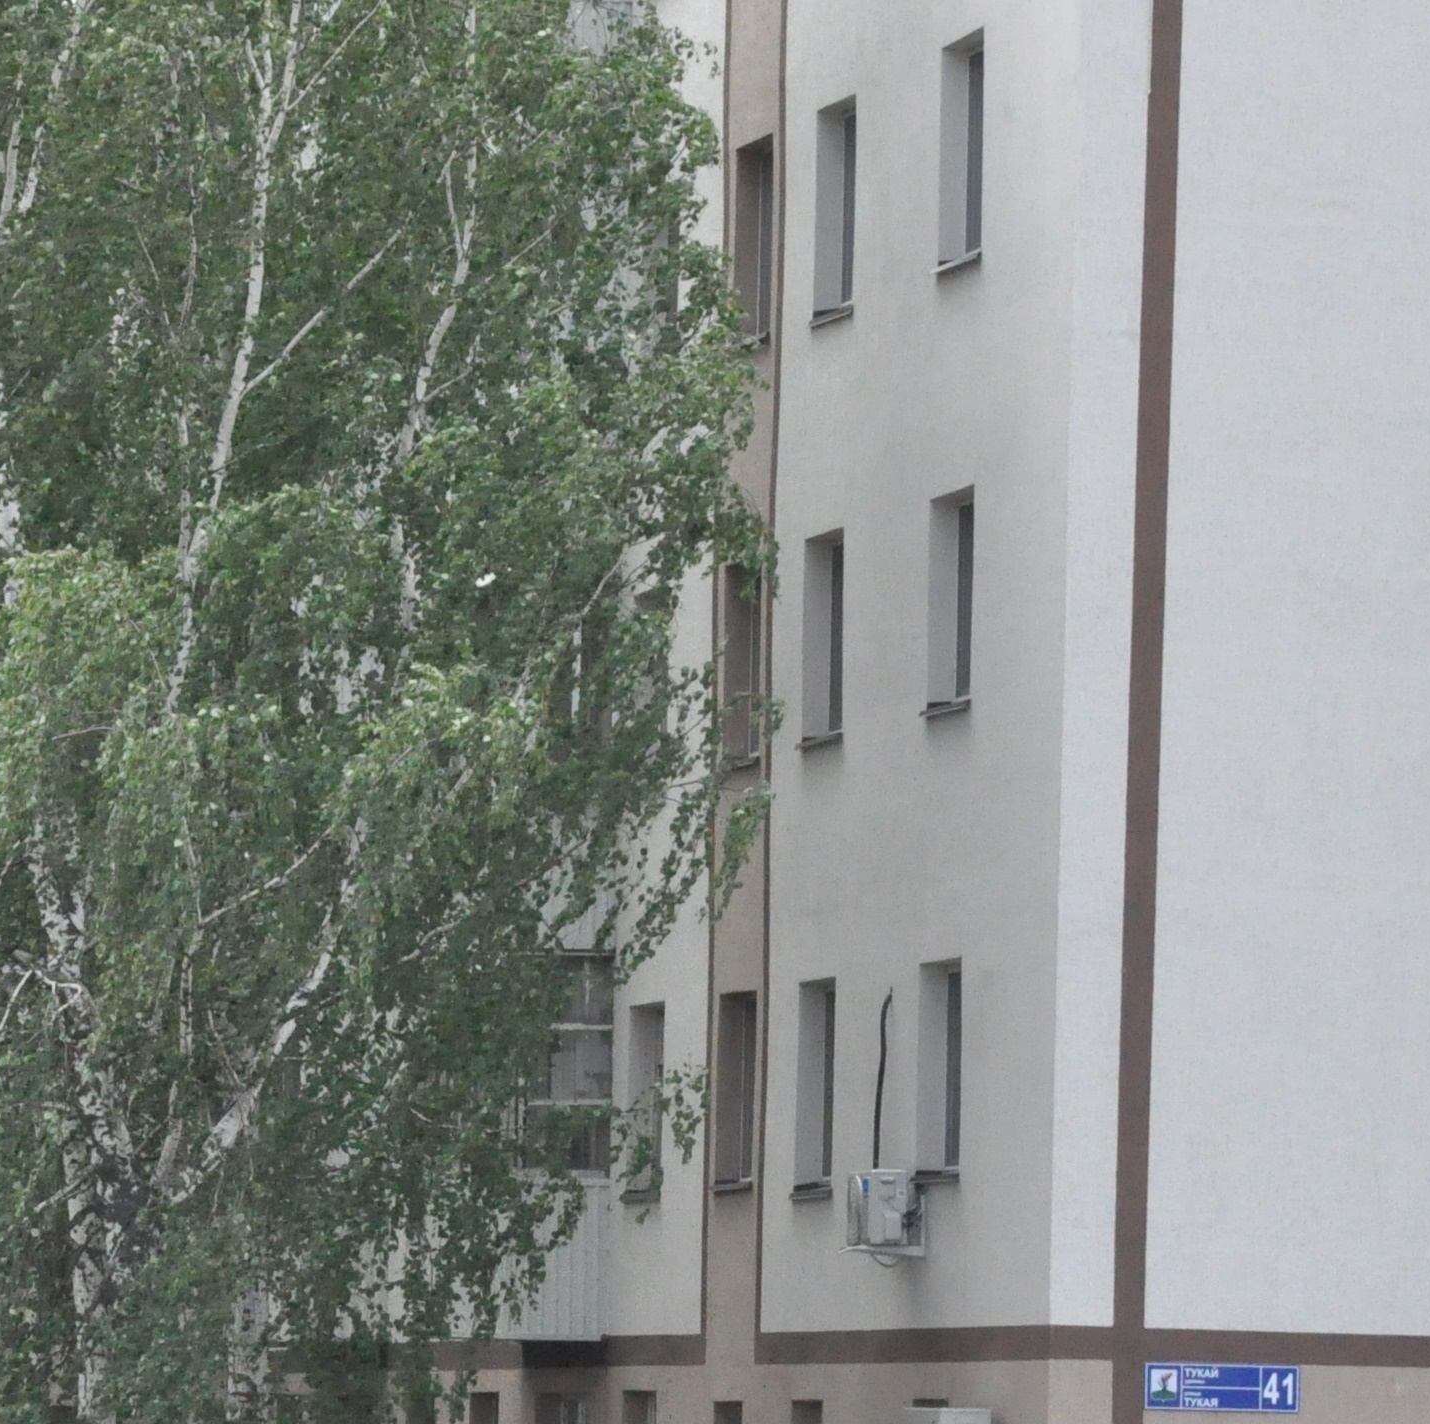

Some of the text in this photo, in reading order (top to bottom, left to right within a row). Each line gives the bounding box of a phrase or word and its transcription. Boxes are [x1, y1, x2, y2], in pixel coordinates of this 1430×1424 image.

[1184, 1366, 1219, 1379] ТУКАЙ
[1263, 1372, 1294, 1406] 41
[1184, 1397, 1219, 1408] ТУКАЯ
